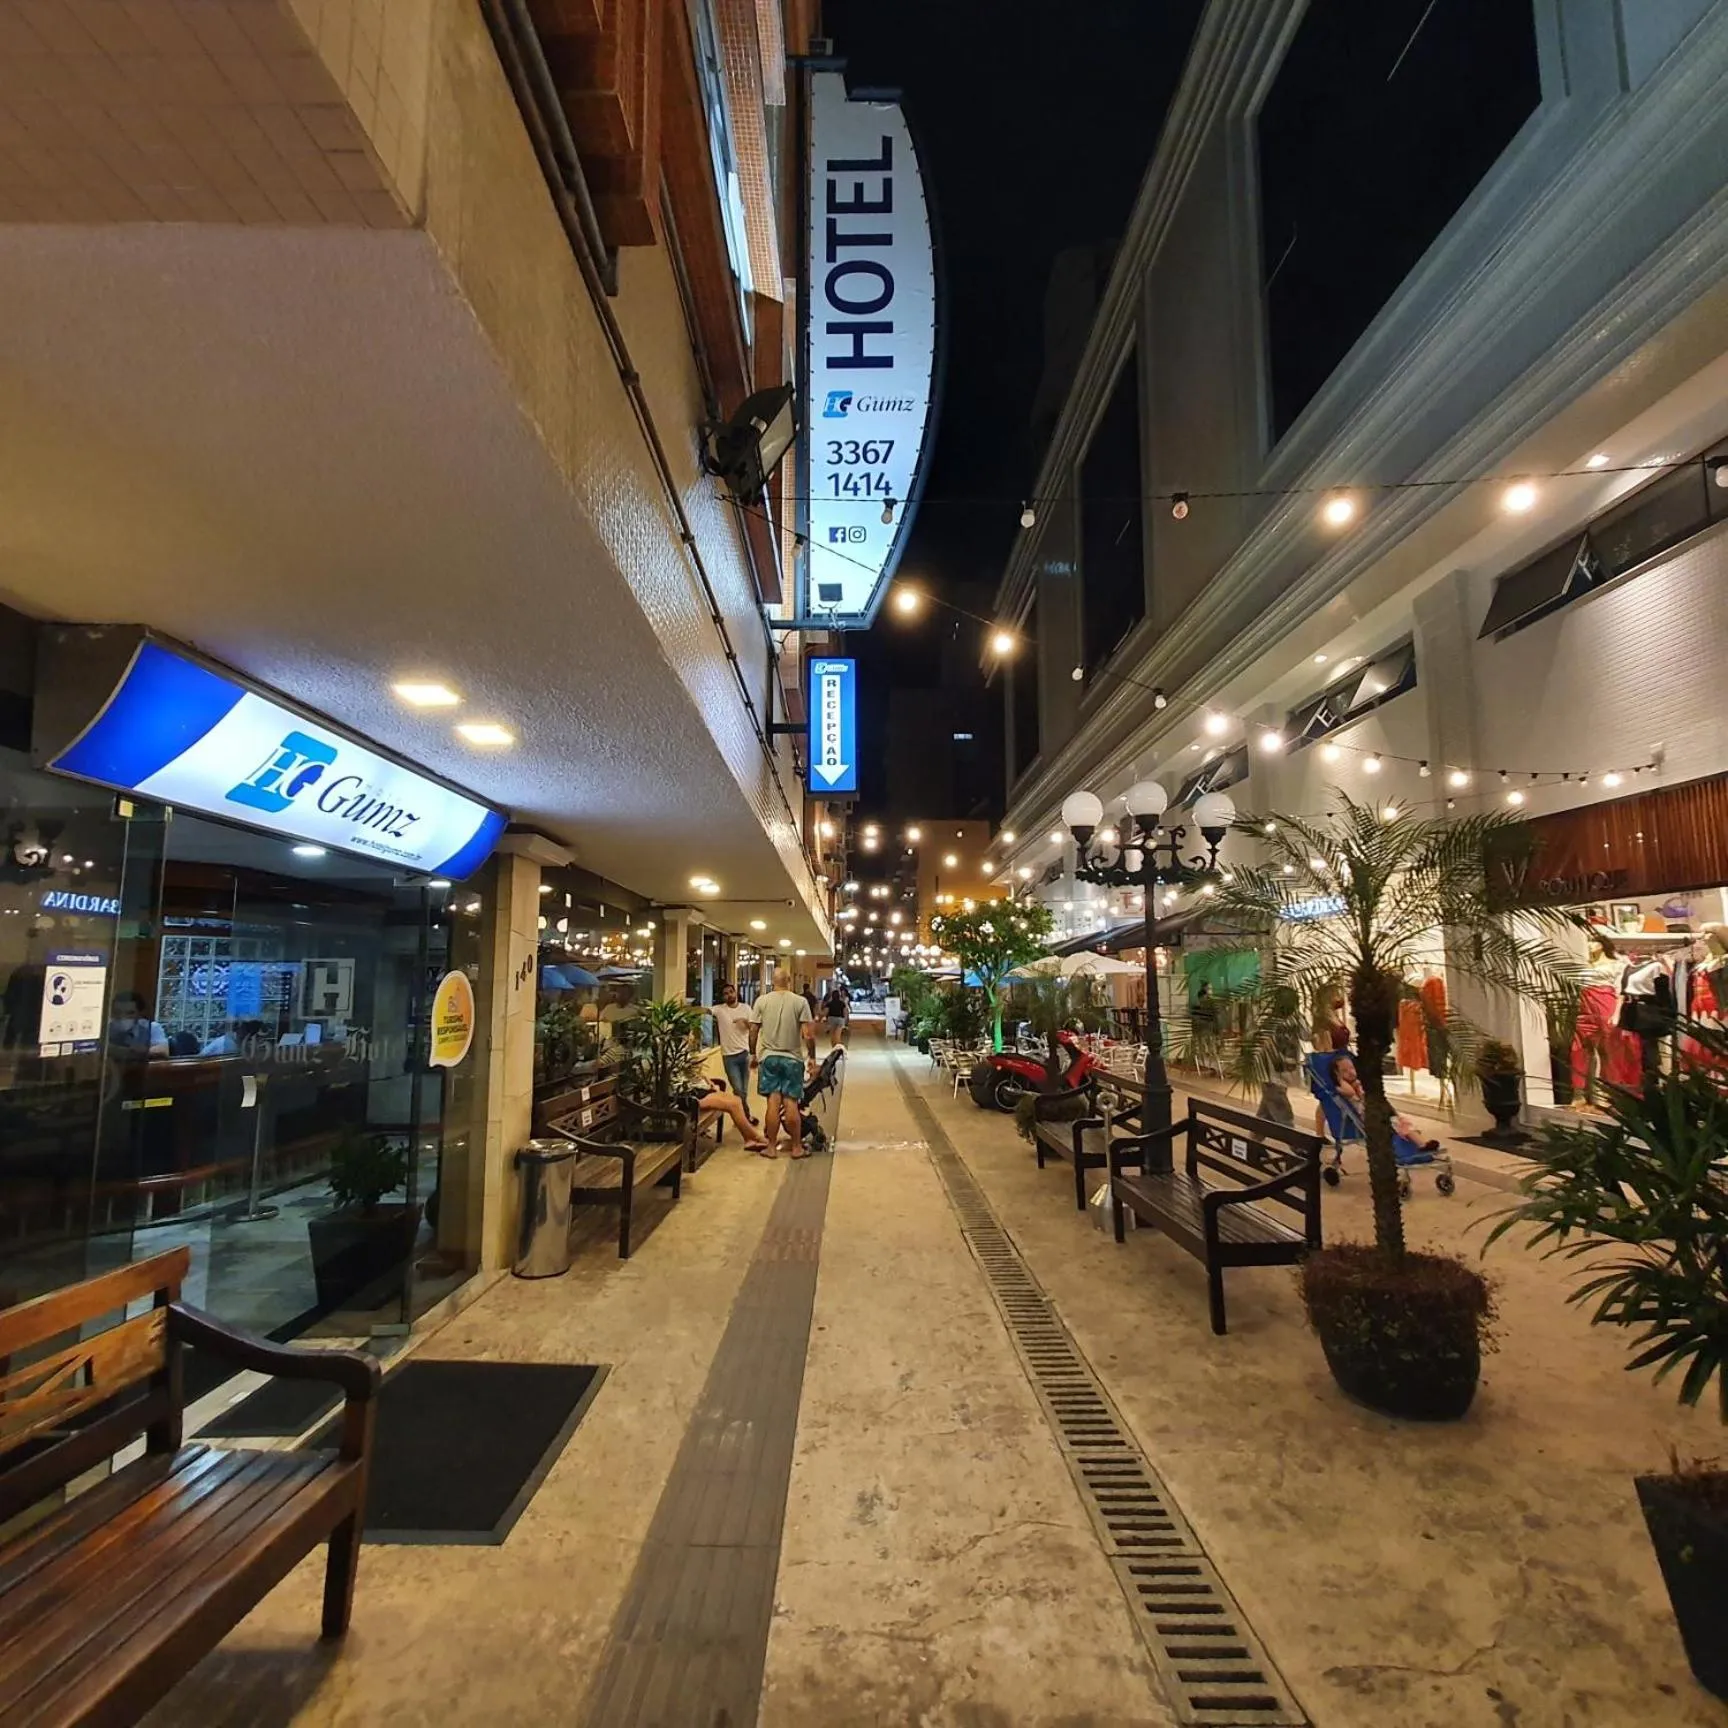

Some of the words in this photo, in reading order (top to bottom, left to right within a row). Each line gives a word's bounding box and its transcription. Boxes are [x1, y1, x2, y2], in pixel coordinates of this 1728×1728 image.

[825, 135, 895, 368] HOTEL
[827, 440, 895, 465] 3367
[827, 472, 893, 497] 1414
[317, 775, 421, 838] Gumz
[515, 953, 533, 991] 140
